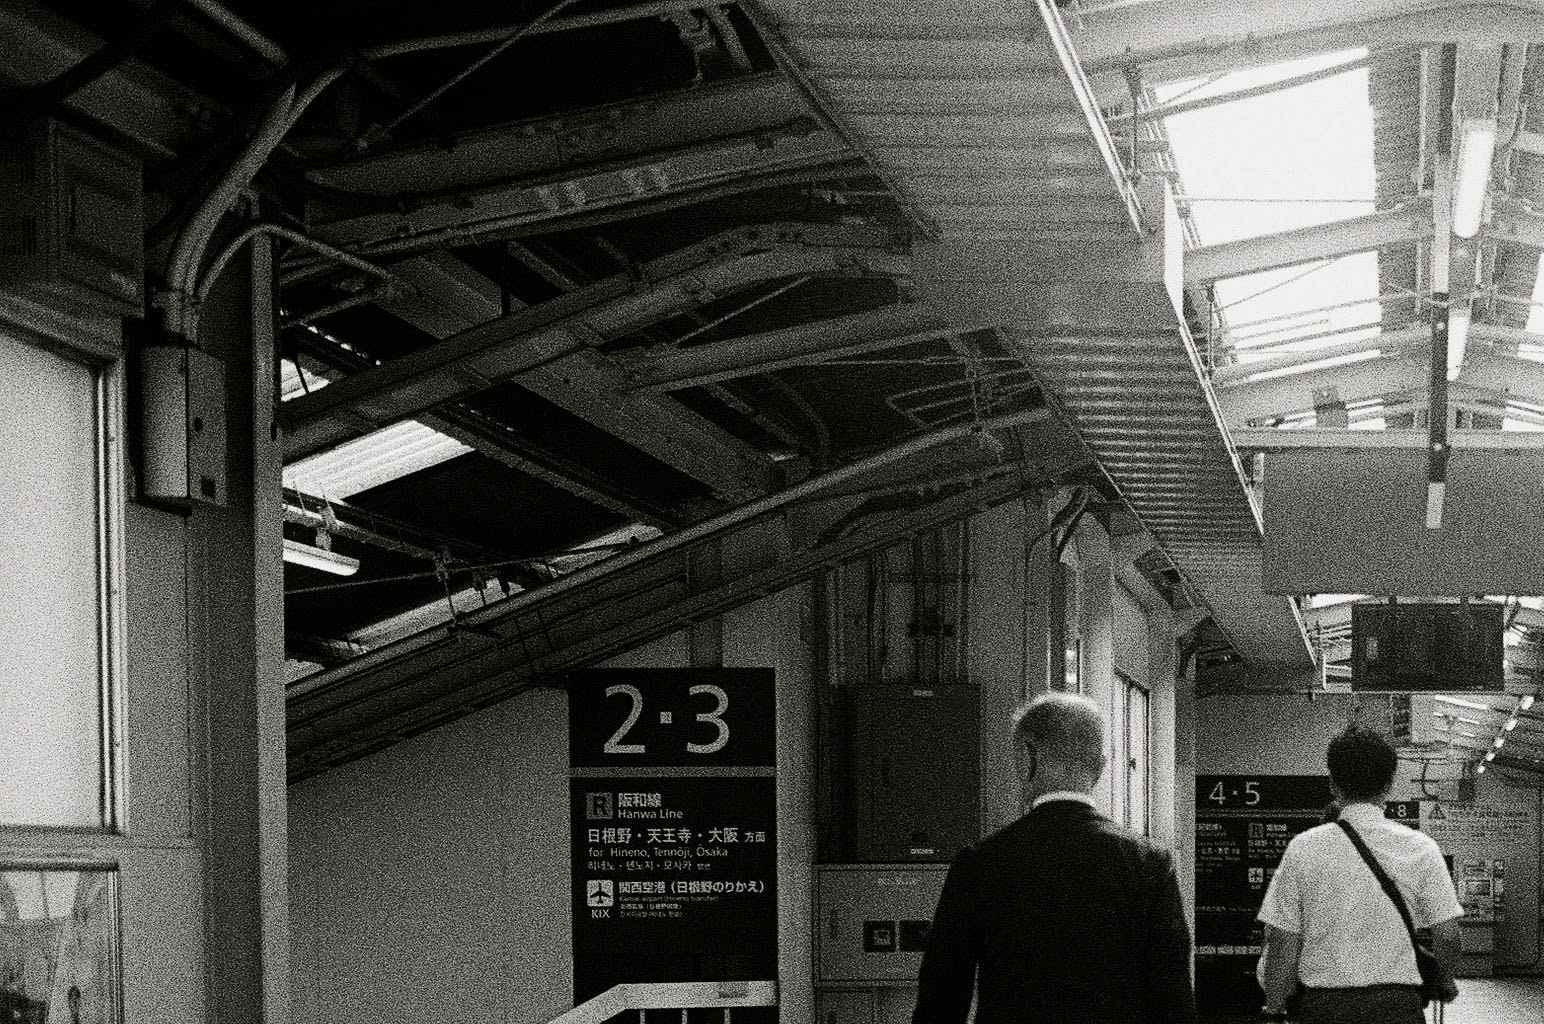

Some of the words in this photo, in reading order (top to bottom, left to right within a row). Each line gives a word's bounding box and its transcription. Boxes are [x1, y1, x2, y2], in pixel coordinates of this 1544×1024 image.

[593, 796, 607, 815] R
[618, 793, 662, 808] 阪和線
[618, 809, 657, 819] Hanwa
[659, 808, 683, 819] Line
[588, 847, 604, 857] for
[610, 847, 650, 858] Hineno,
[591, 909, 610, 919] KIX
